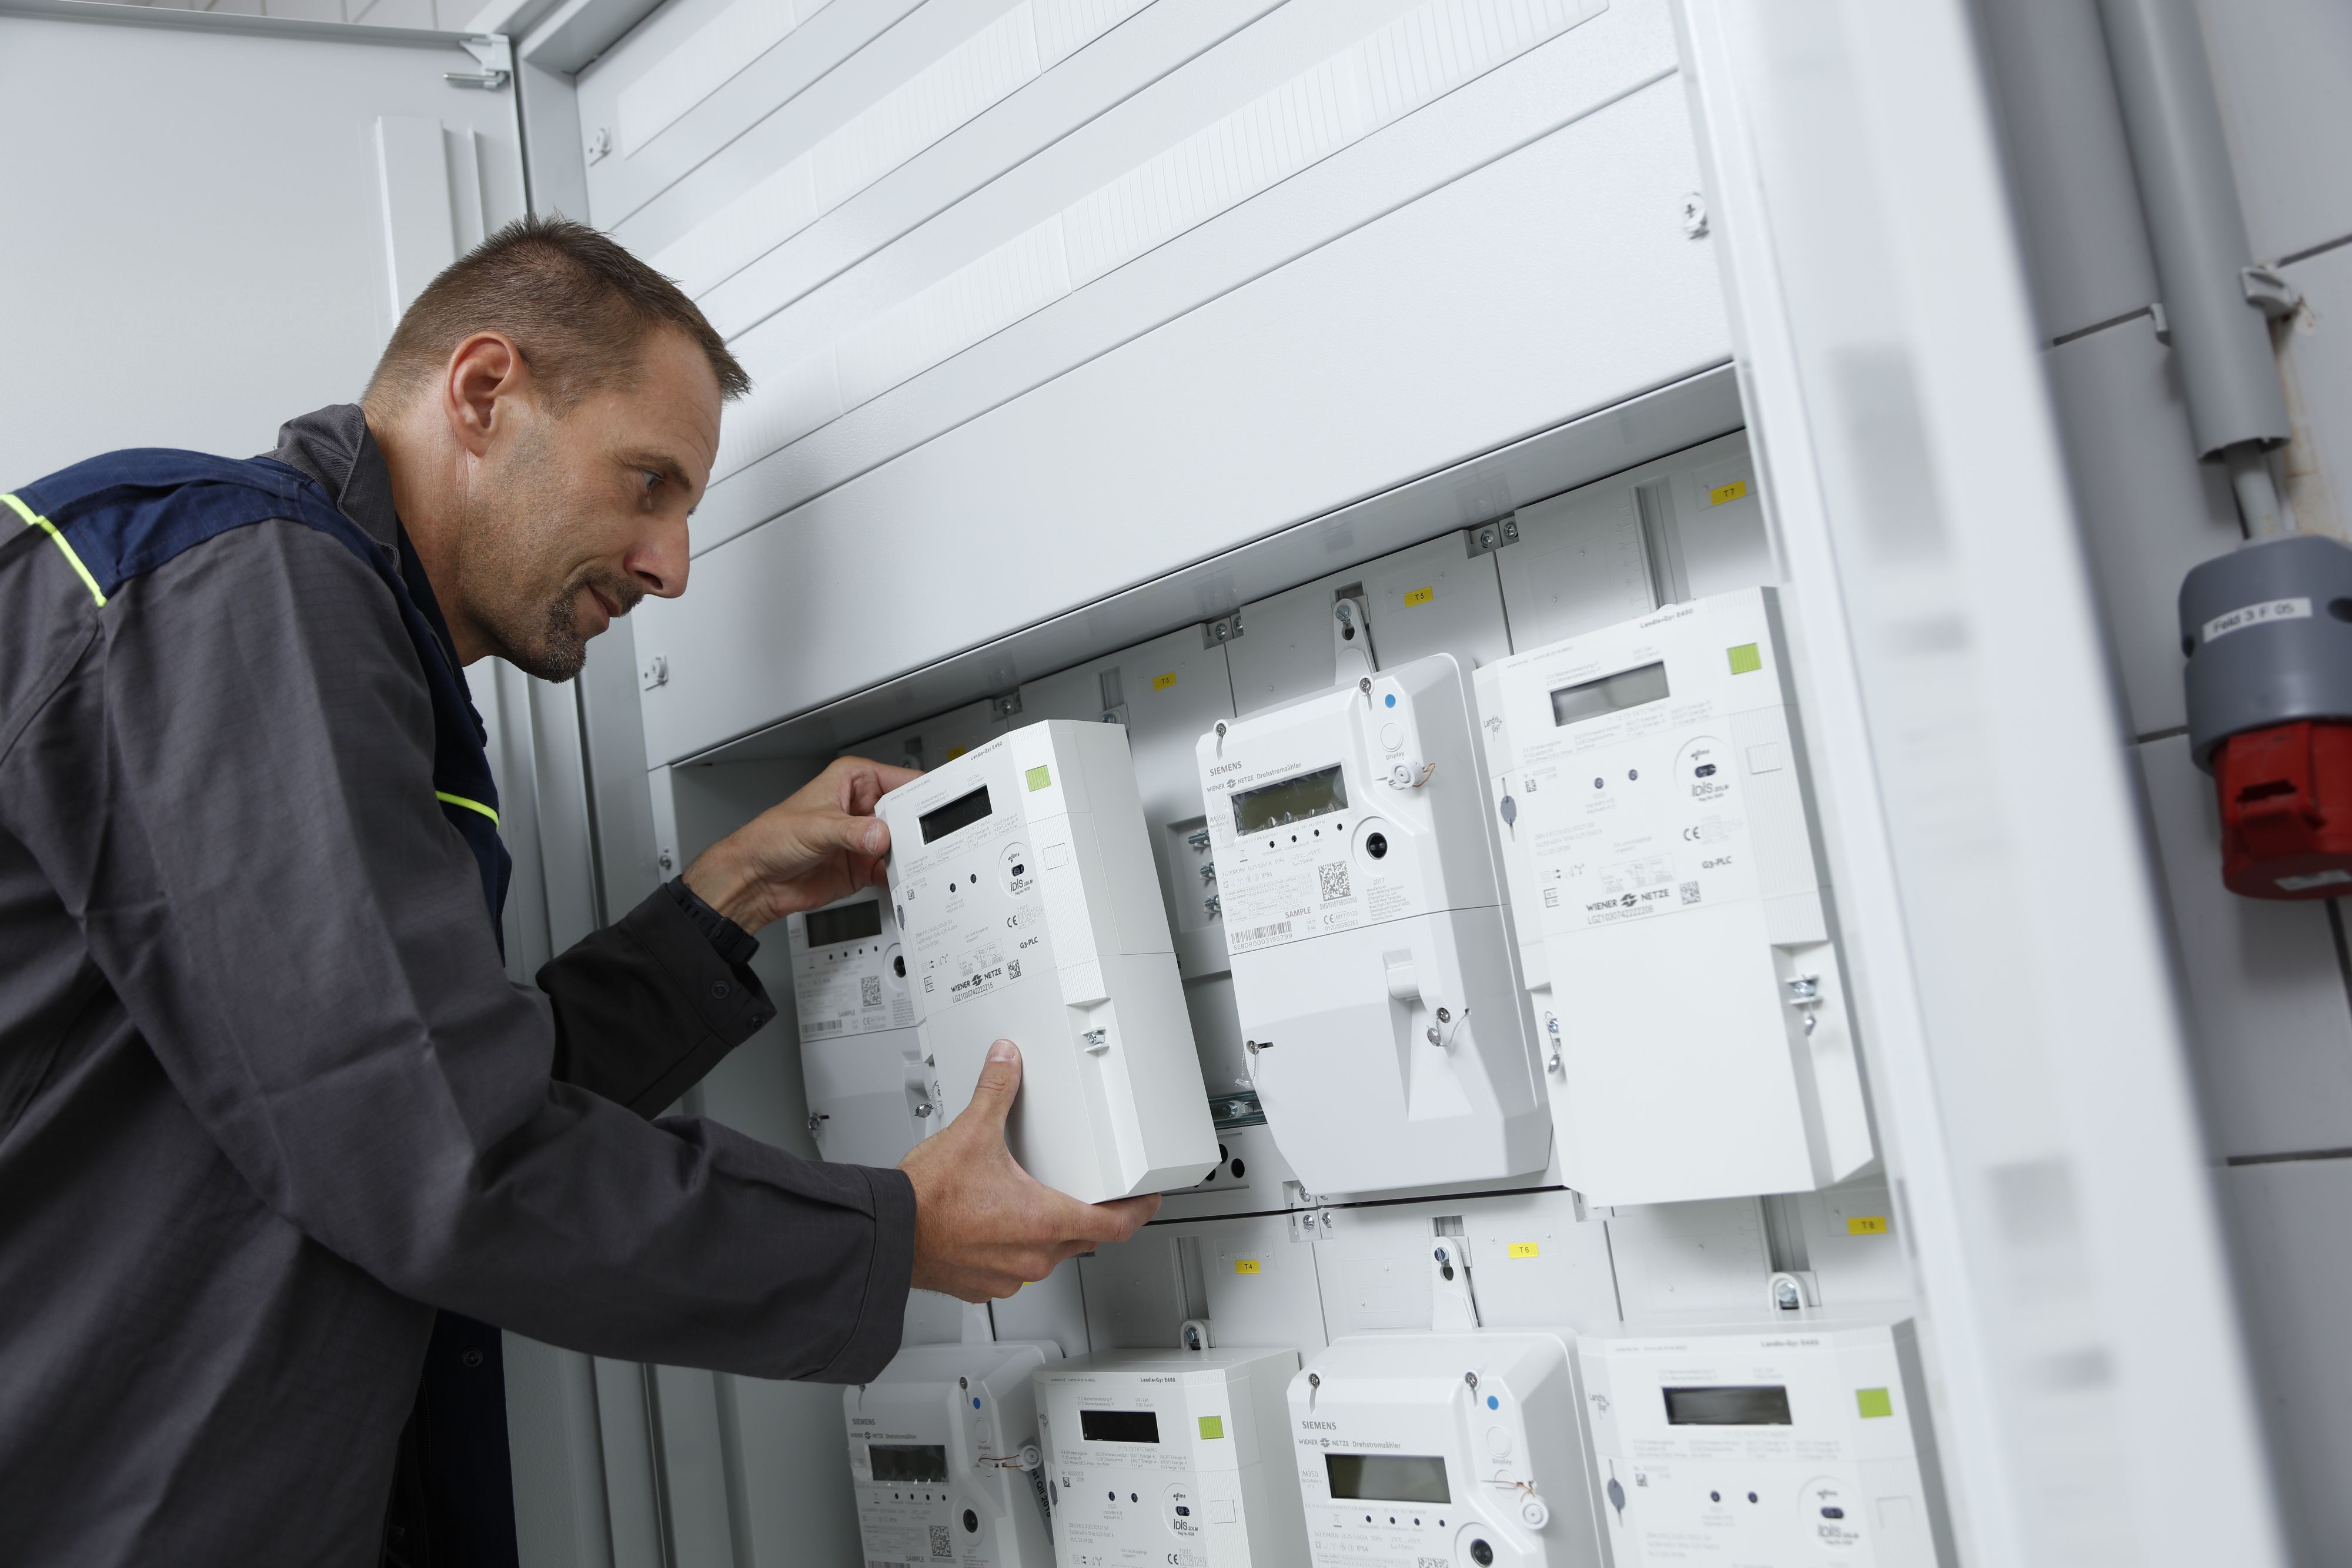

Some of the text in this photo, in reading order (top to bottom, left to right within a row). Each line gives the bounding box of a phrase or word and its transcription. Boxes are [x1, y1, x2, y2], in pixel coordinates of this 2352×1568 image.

[2213, 603, 2294, 633] Feld 3 F 05
[970, 741, 1003, 761] Landis+Gyr E450
[1386, 751, 1405, 760] Display
[1210, 761, 1242, 777] SIEMENS
[1207, 762, 1302, 793] WIENER NETZE Drehstromzähler
[1210, 814, 1225, 823] IM350
[1024, 879, 1033, 887] 2DLM
[1373, 877, 1385, 885] 2017
[1586, 889, 1670, 912] WIENER NETZE
[1031, 905, 1043, 917] 1259
[1285, 907, 1312, 919] SAMPLE
[1335, 912, 1347, 921] M17
[1020, 937, 1038, 949] G3-PLC
[951, 968, 1002, 993] WIENER NETZE
[838, 1009, 856, 1018] SAMPLE
[1302, 1420, 1337, 1430] SIEMENS
[1194, 1557, 1207, 1566] 1259
